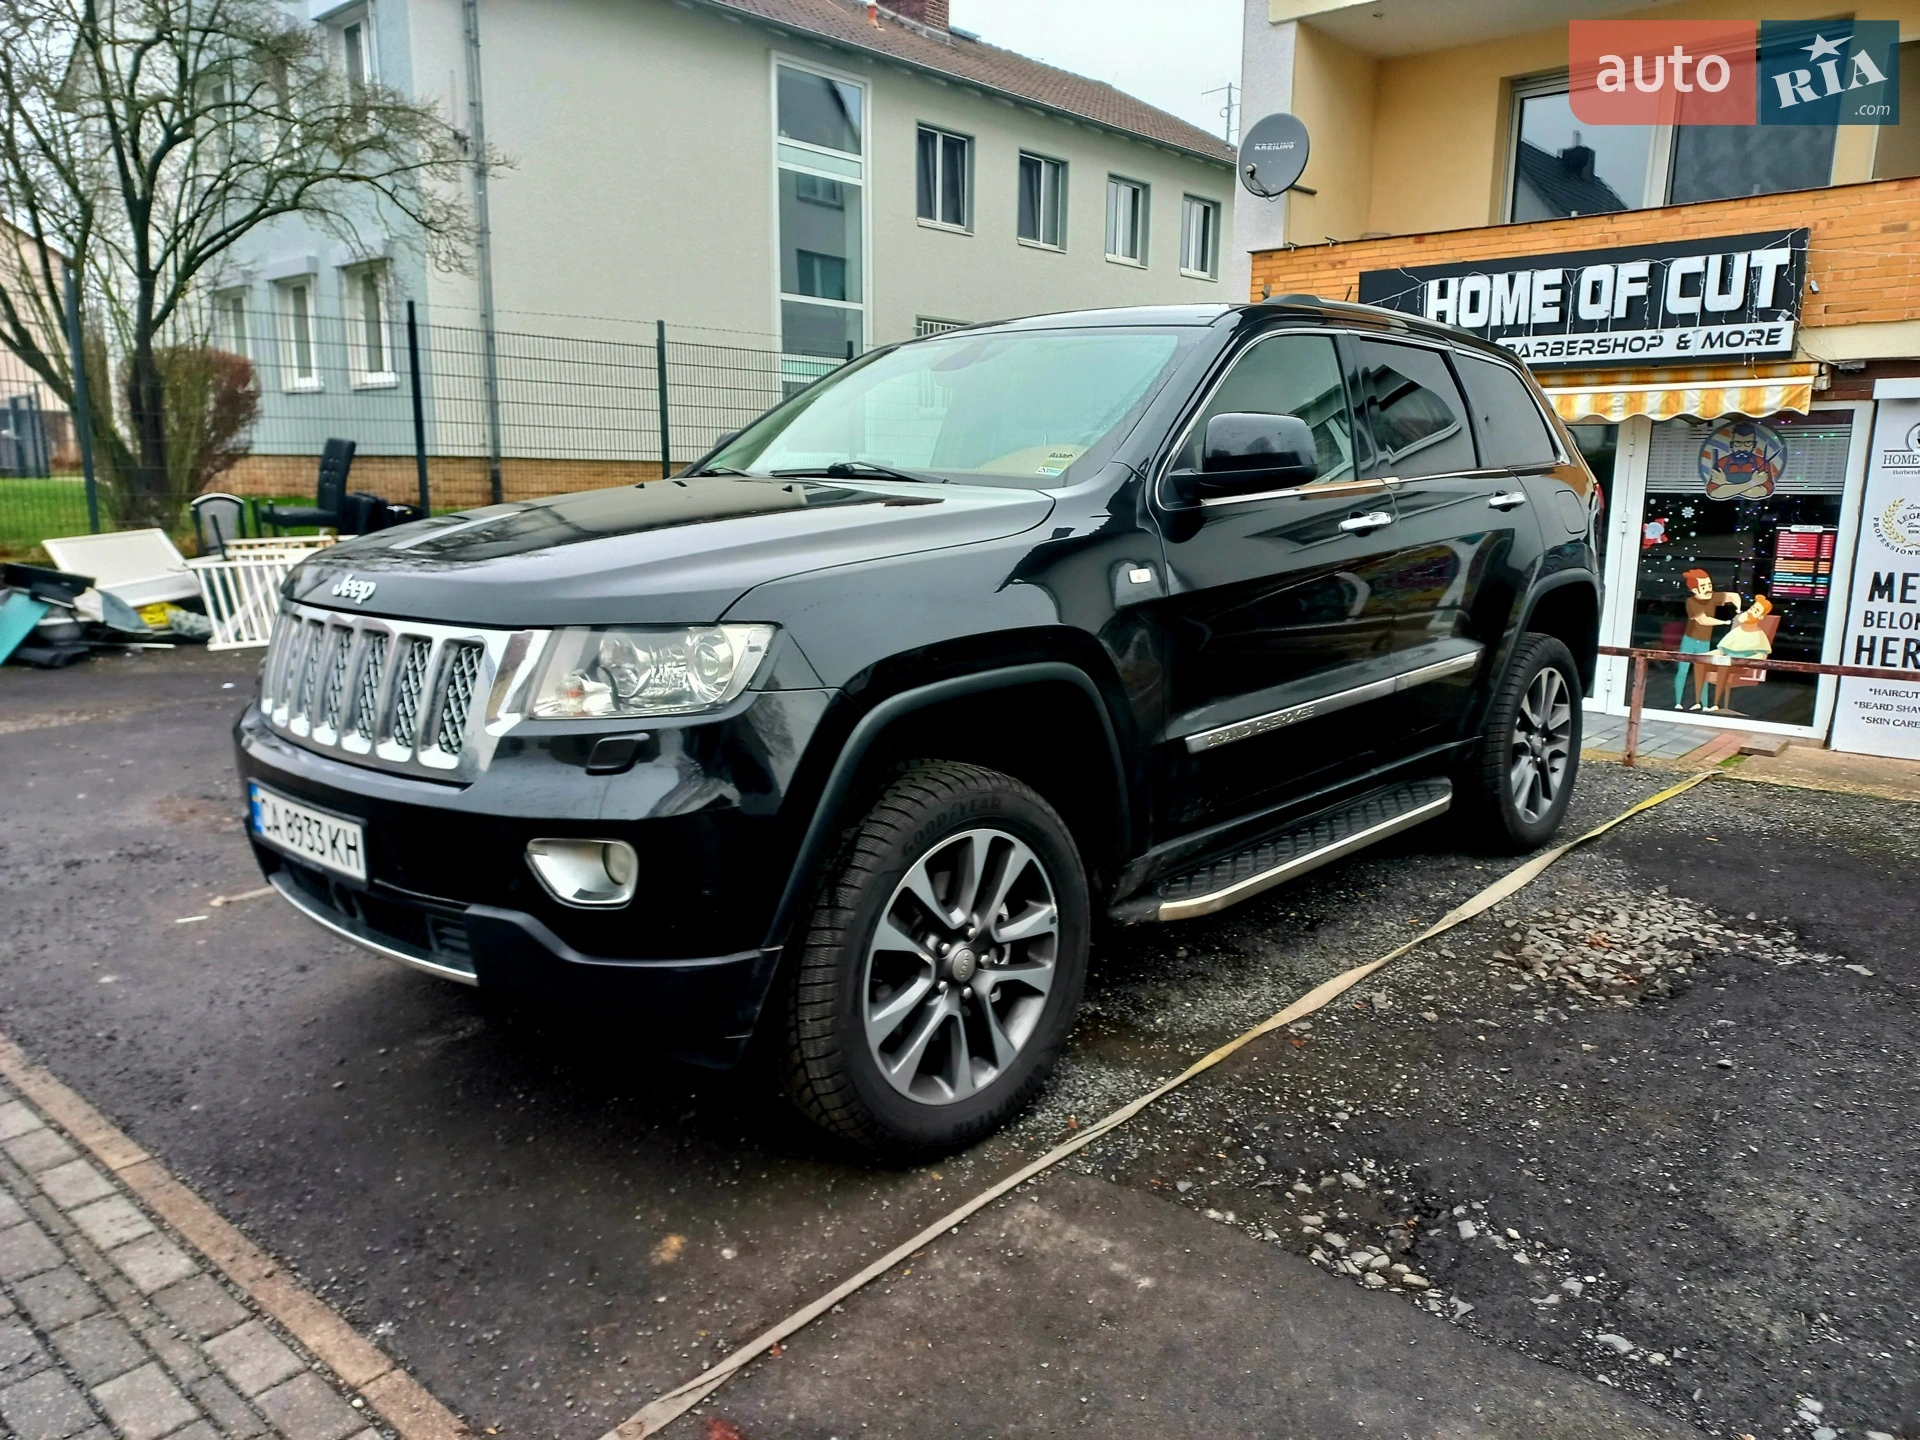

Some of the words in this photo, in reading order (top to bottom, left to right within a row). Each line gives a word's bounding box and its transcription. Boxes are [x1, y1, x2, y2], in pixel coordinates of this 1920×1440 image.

[1425, 268, 1564, 329] HOME
[1578, 261, 1651, 321] OF
[1666, 247, 1792, 315] CUT
[1676, 332, 1693, 350] &
[1702, 327, 1785, 350] MORE
[1883, 454, 1920, 465] HOME
[332, 573, 377, 605] Jeep
[1867, 571, 1920, 604] ME
[1896, 704, 1920, 714] SHA
[285, 808, 325, 856] 8933
[327, 825, 361, 871] KH
